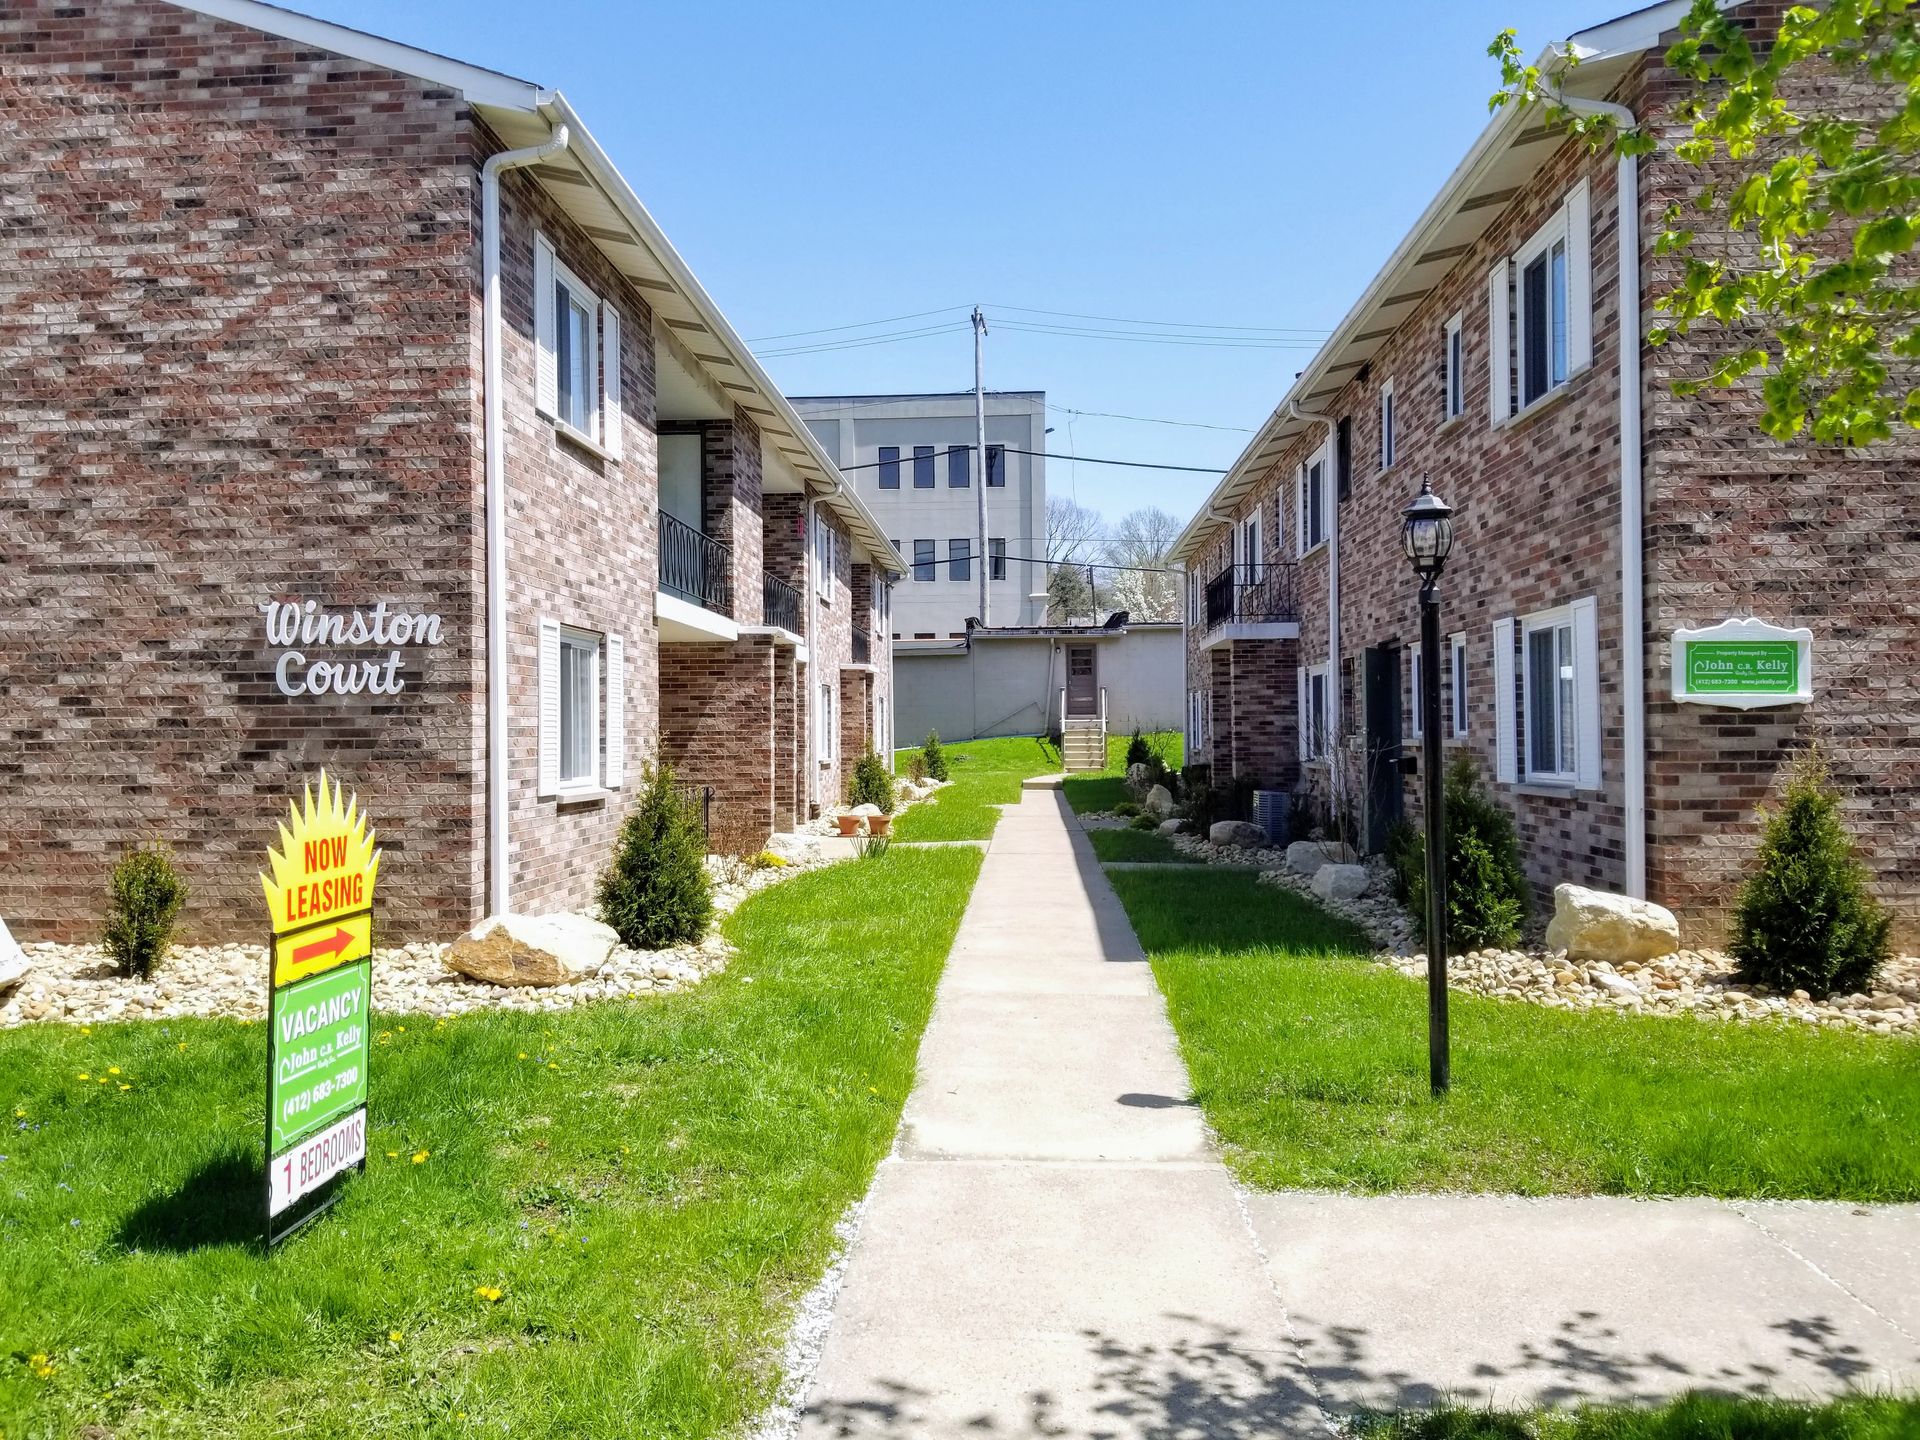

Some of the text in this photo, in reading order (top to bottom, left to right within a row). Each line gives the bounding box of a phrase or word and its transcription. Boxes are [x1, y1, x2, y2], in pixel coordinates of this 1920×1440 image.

[258, 600, 444, 646] Winston
[276, 650, 405, 696] Court
[1705, 660, 1733, 671] John
[1756, 660, 1788, 672] Kelly
[304, 835, 348, 875] NOW
[287, 872, 363, 922] LEASING
[282, 987, 362, 1043] VACANCY
[290, 1046, 317, 1074] John
[336, 1025, 362, 1050] Kelly
[283, 1066, 358, 1123] (412) 683-7300
[283, 1119, 361, 1195] 1 BEDROOMS
